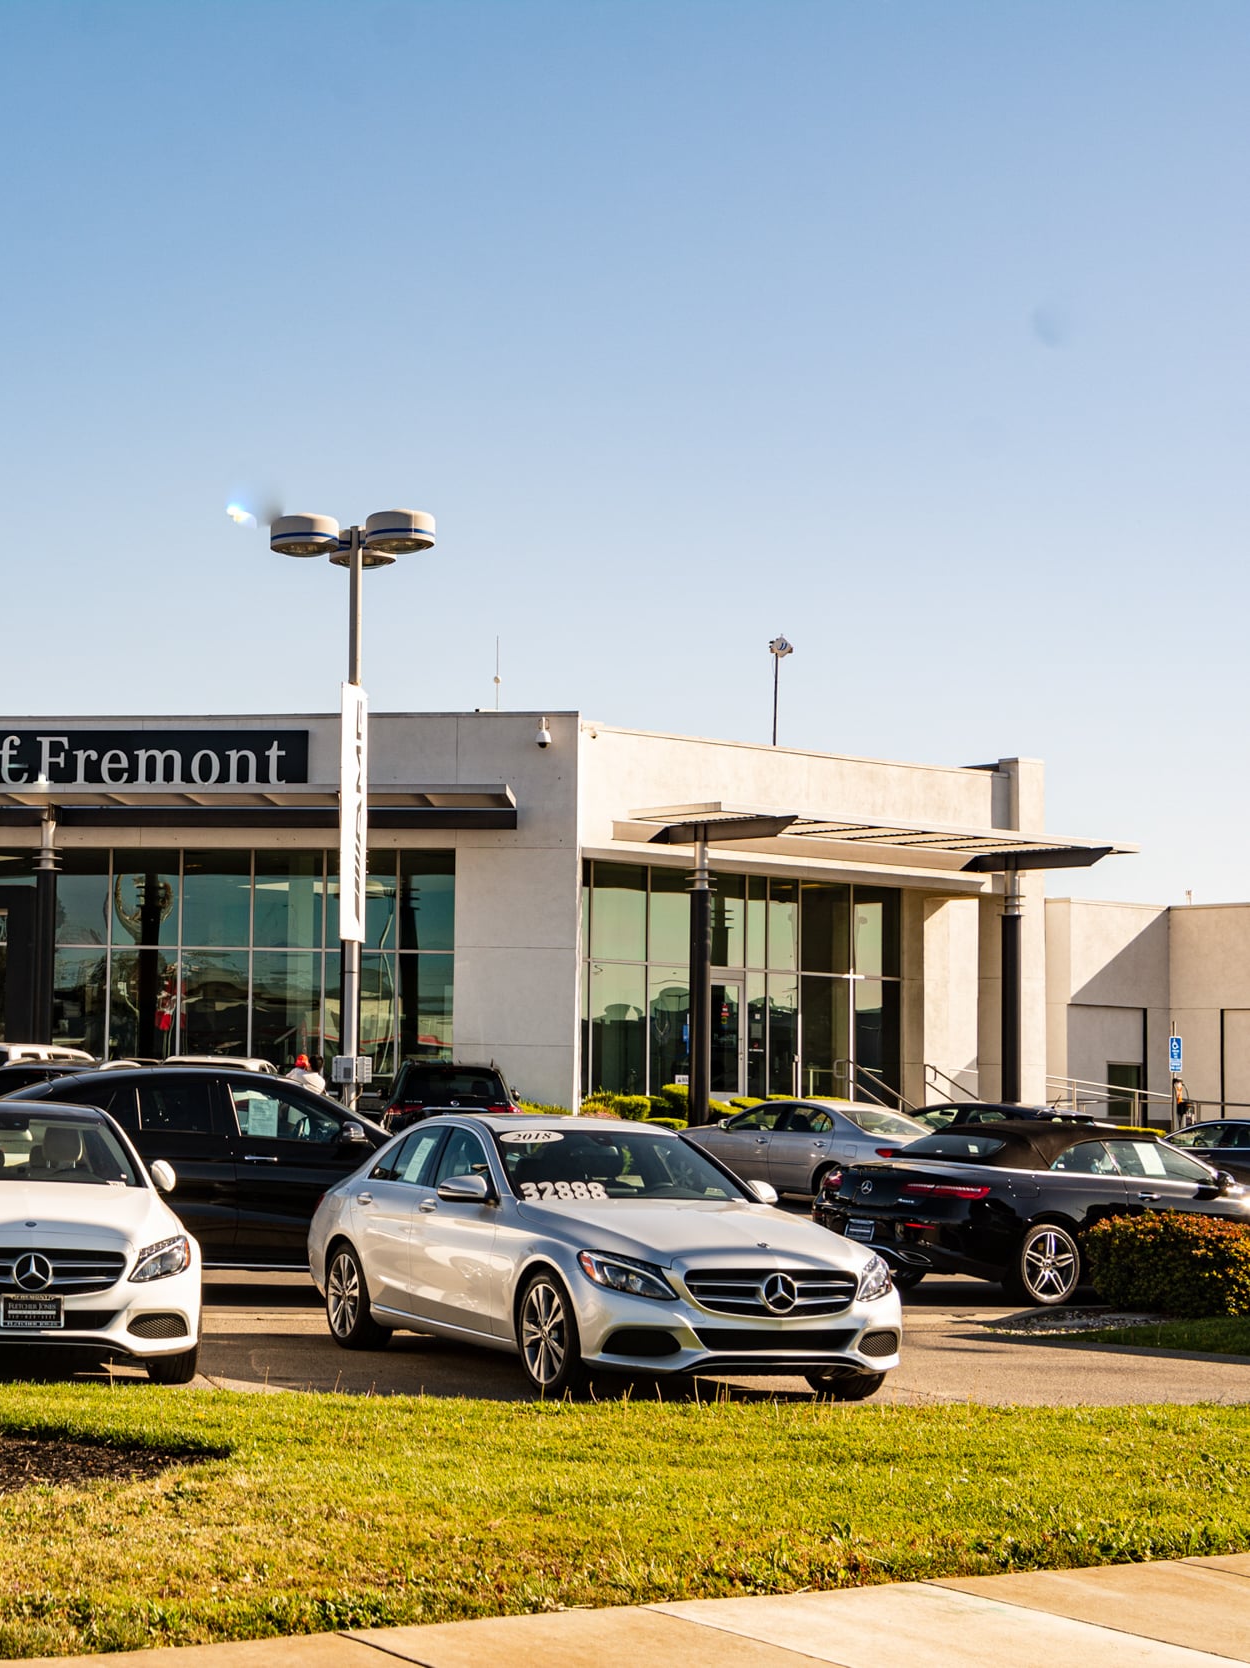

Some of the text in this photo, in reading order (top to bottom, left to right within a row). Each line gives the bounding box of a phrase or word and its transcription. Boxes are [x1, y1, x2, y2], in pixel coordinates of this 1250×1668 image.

[33, 736, 286, 785] Fremont
[512, 1132, 552, 1141] 2018
[520, 1181, 609, 1200] 32888
